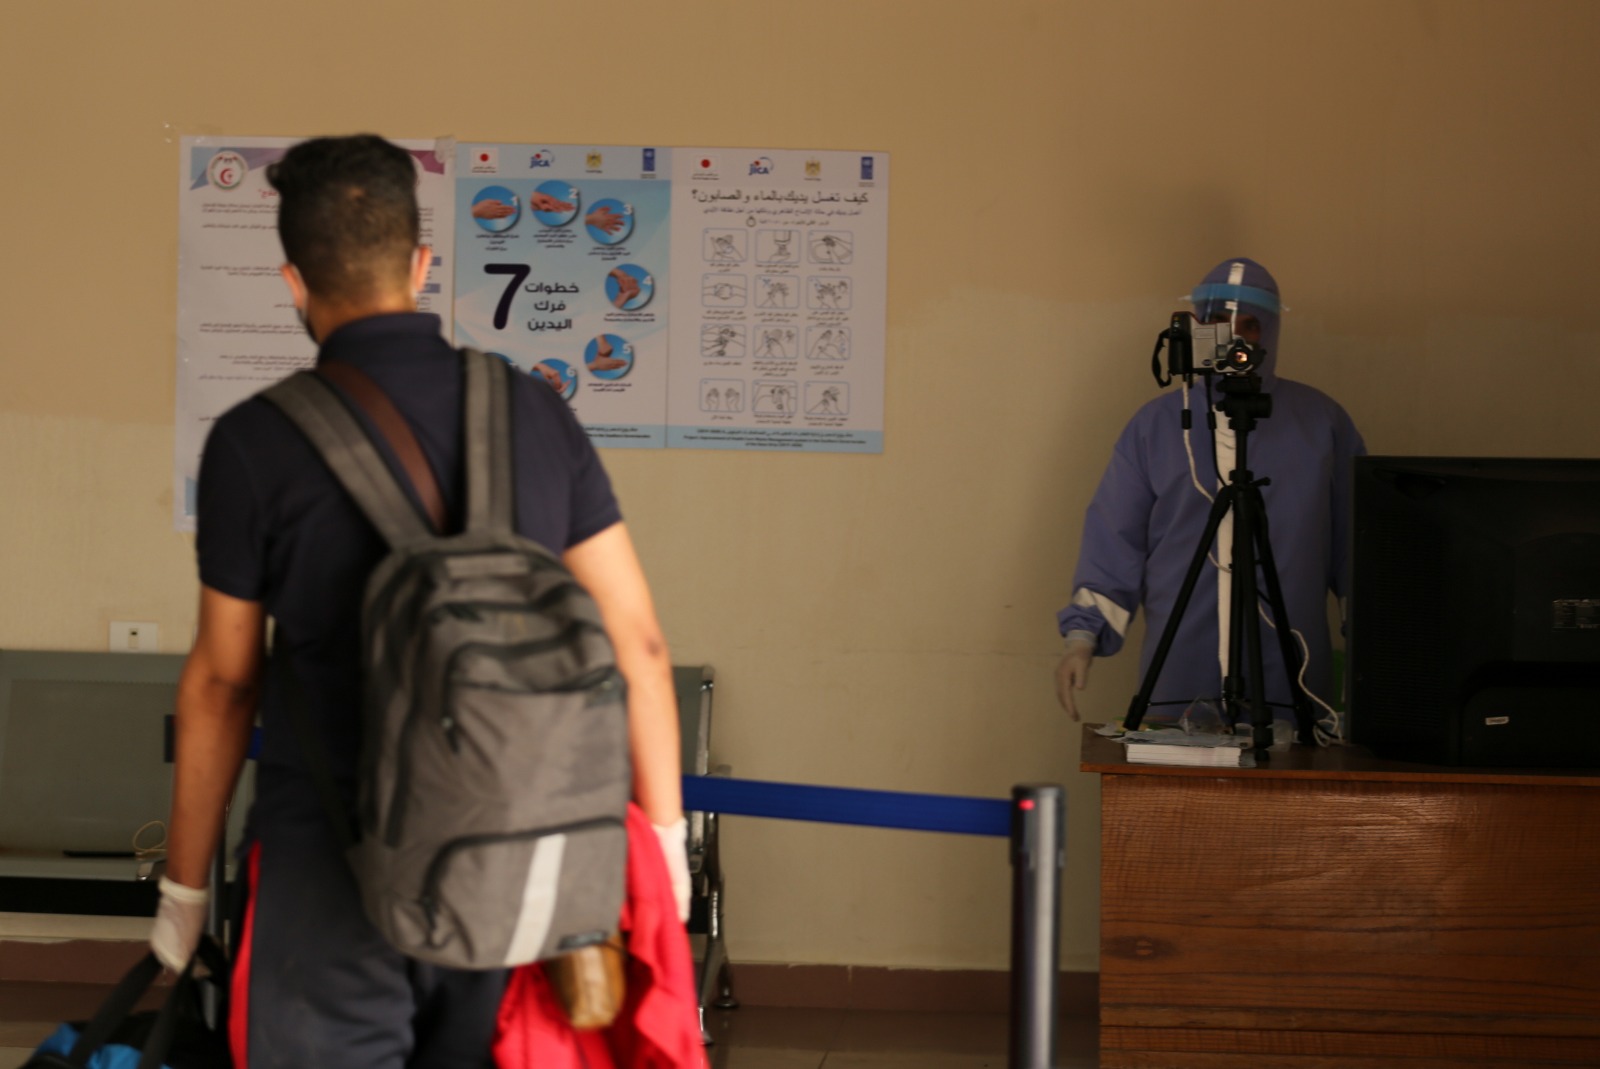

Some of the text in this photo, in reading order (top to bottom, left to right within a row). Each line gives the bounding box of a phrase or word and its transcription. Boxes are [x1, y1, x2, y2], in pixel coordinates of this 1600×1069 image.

[530, 154, 550, 169] JICA
[748, 163, 769, 176] JICA
[568, 188, 577, 199] 2
[753, 190, 783, 203] بالماء
[812, 191, 840, 203] تغسل
[844, 192, 869, 205] كيف
[511, 196, 519, 206] 1
[623, 204, 633, 215] 3
[643, 275, 653, 285] 4
[525, 281, 579, 294] خطوات
[484, 263, 531, 330] 7
[534, 300, 566, 313] فرك
[528, 319, 572, 332] اليدين
[623, 344, 632, 355] 5
[567, 367, 576, 378] 6
